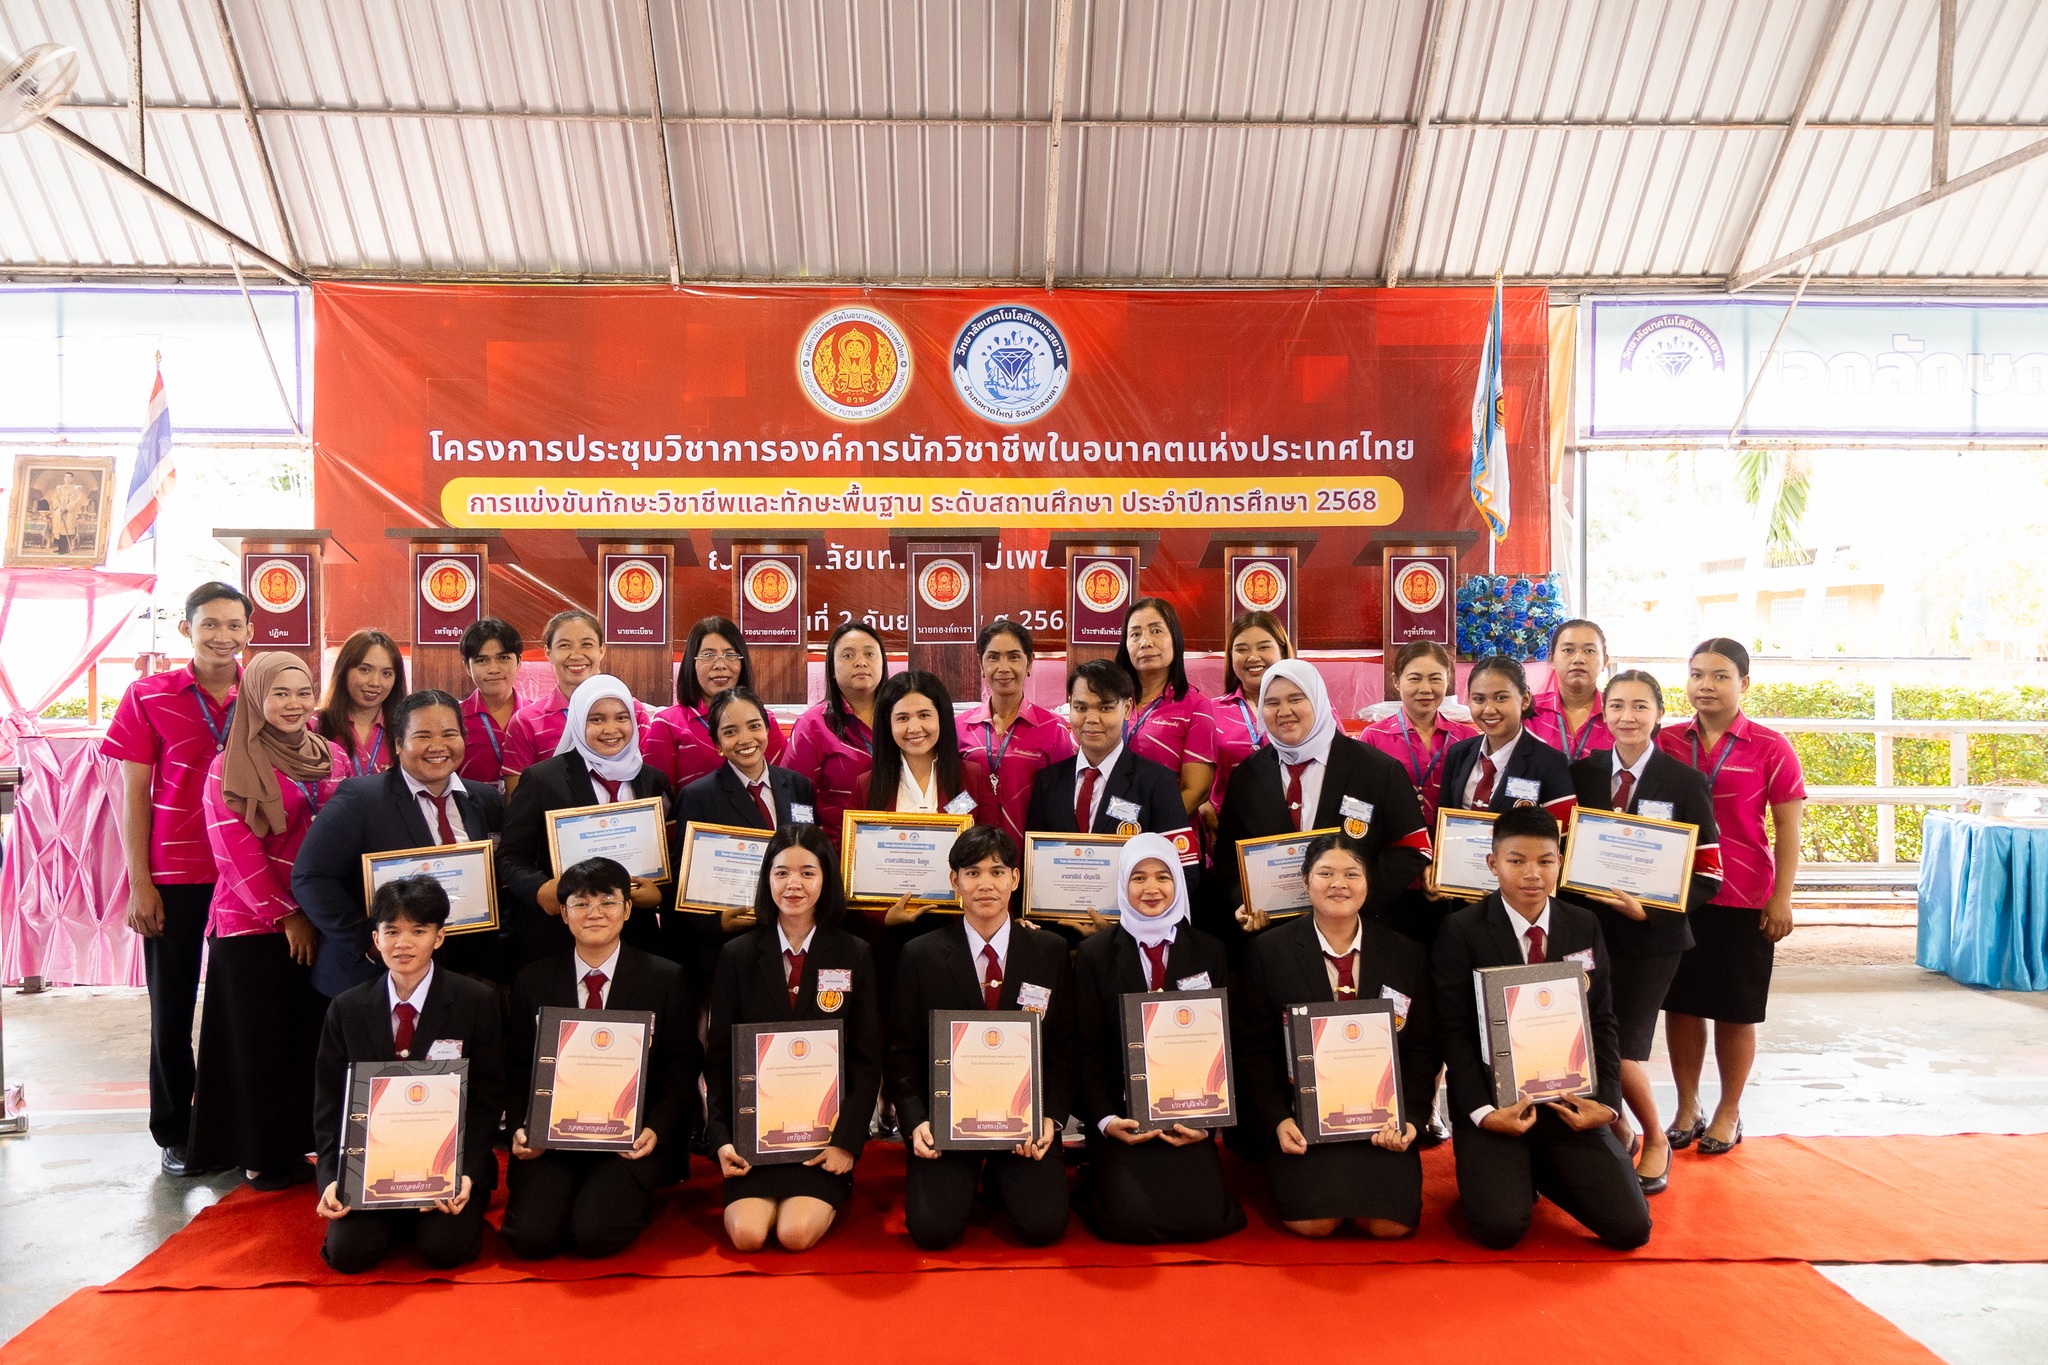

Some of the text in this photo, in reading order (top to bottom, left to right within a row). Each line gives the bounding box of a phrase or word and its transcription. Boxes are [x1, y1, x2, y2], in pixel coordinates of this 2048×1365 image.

[956, 309, 1065, 359] วิทยาลัยเทคโนโลยีเพชรสยาม
[839, 408, 863, 417] FUTURE
[865, 405, 880, 417] THAI
[880, 371, 907, 409] PROFESSIONAL
[430, 430, 1415, 470] โครงการประชุมวิชาการองค์การนักวิชาชีพในอนาคตแห่งประเทศไทย
[470, 485, 1377, 518] การแข่งขันทักษะวิชาชีพและทักษะพื้นฐาน ระดับสถานศึกษา ประจำปีการศึกษา 2568
[1018, 610, 1067, 631] 256
